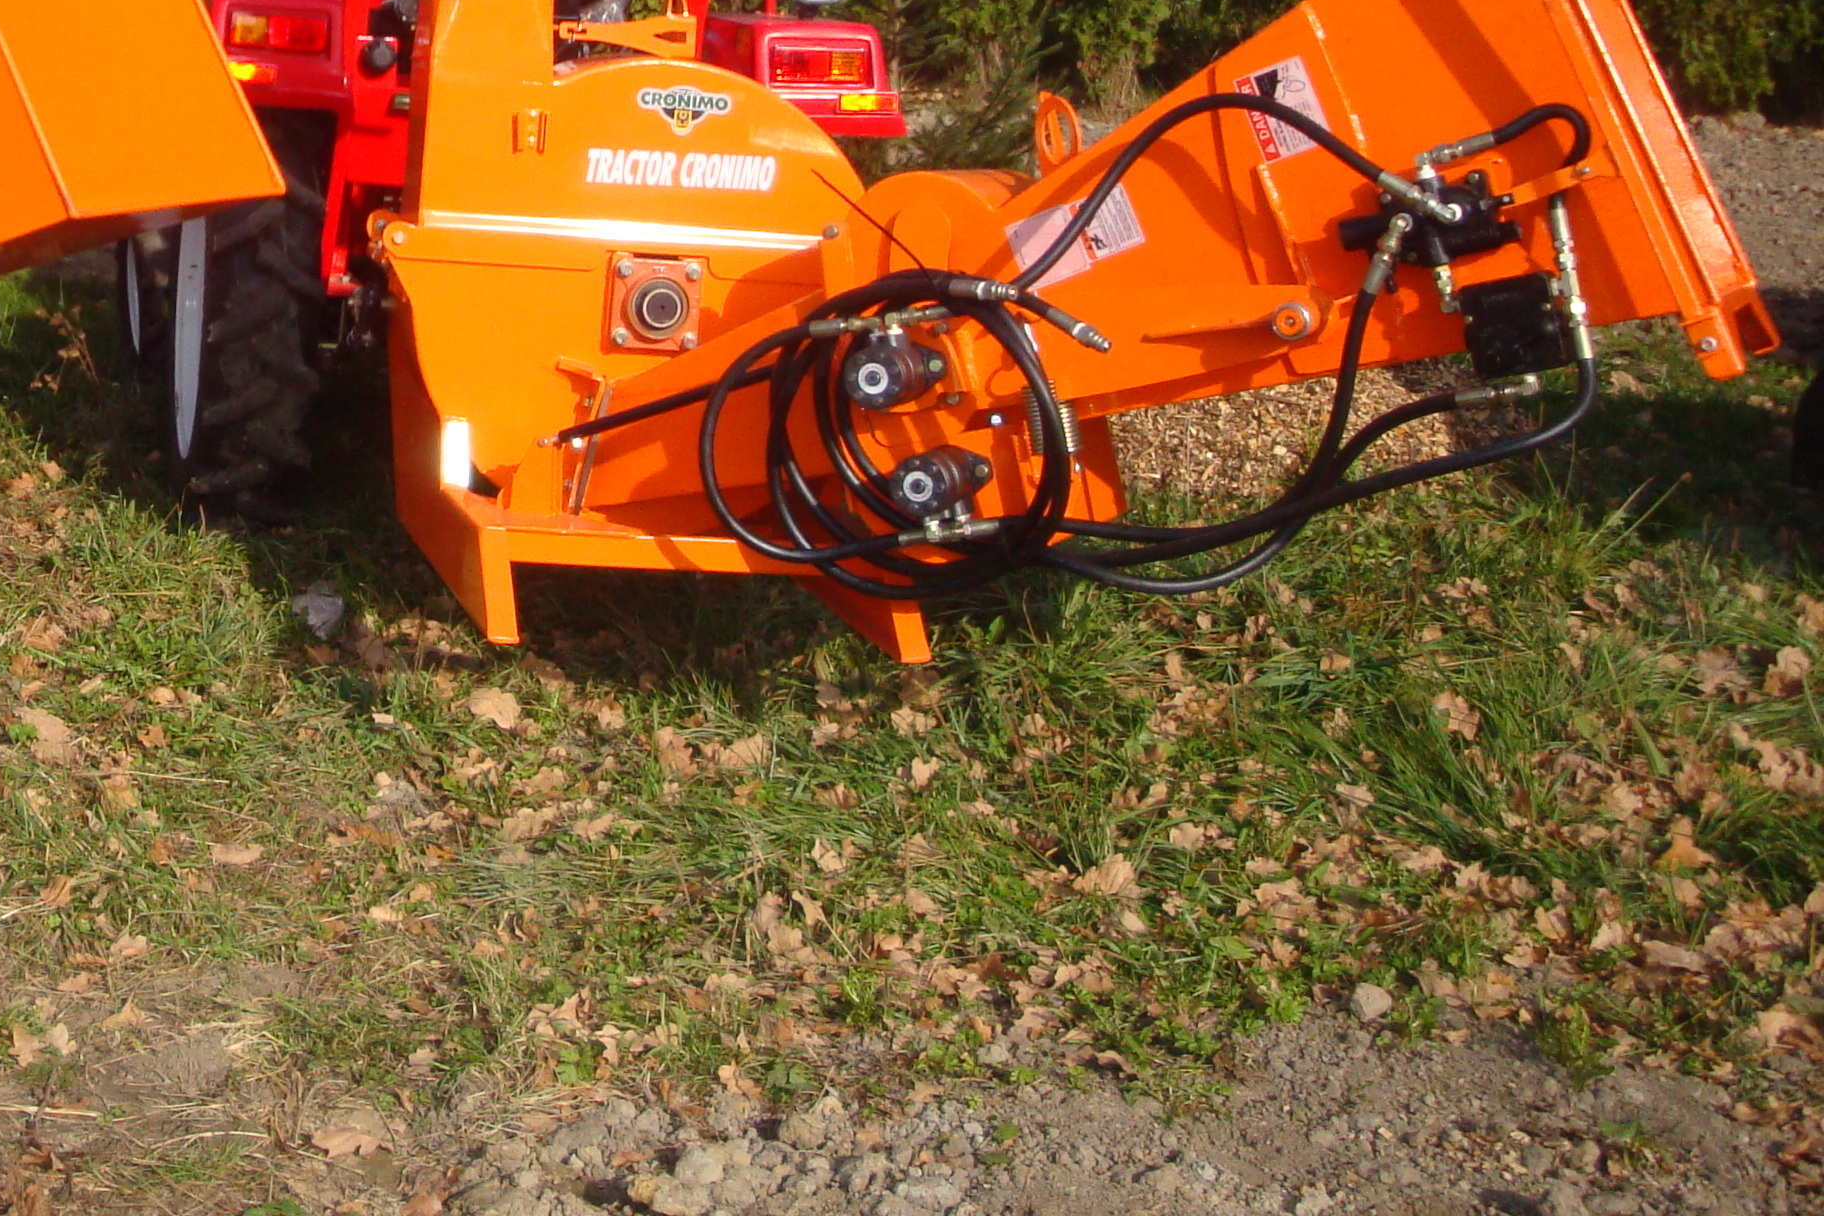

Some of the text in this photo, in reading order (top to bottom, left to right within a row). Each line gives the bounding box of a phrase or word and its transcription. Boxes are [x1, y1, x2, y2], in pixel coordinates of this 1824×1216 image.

[641, 91, 728, 111] CRONIMO
[1240, 83, 1271, 140] DANR
[585, 148, 776, 191] TRACTOR CRONIMO
